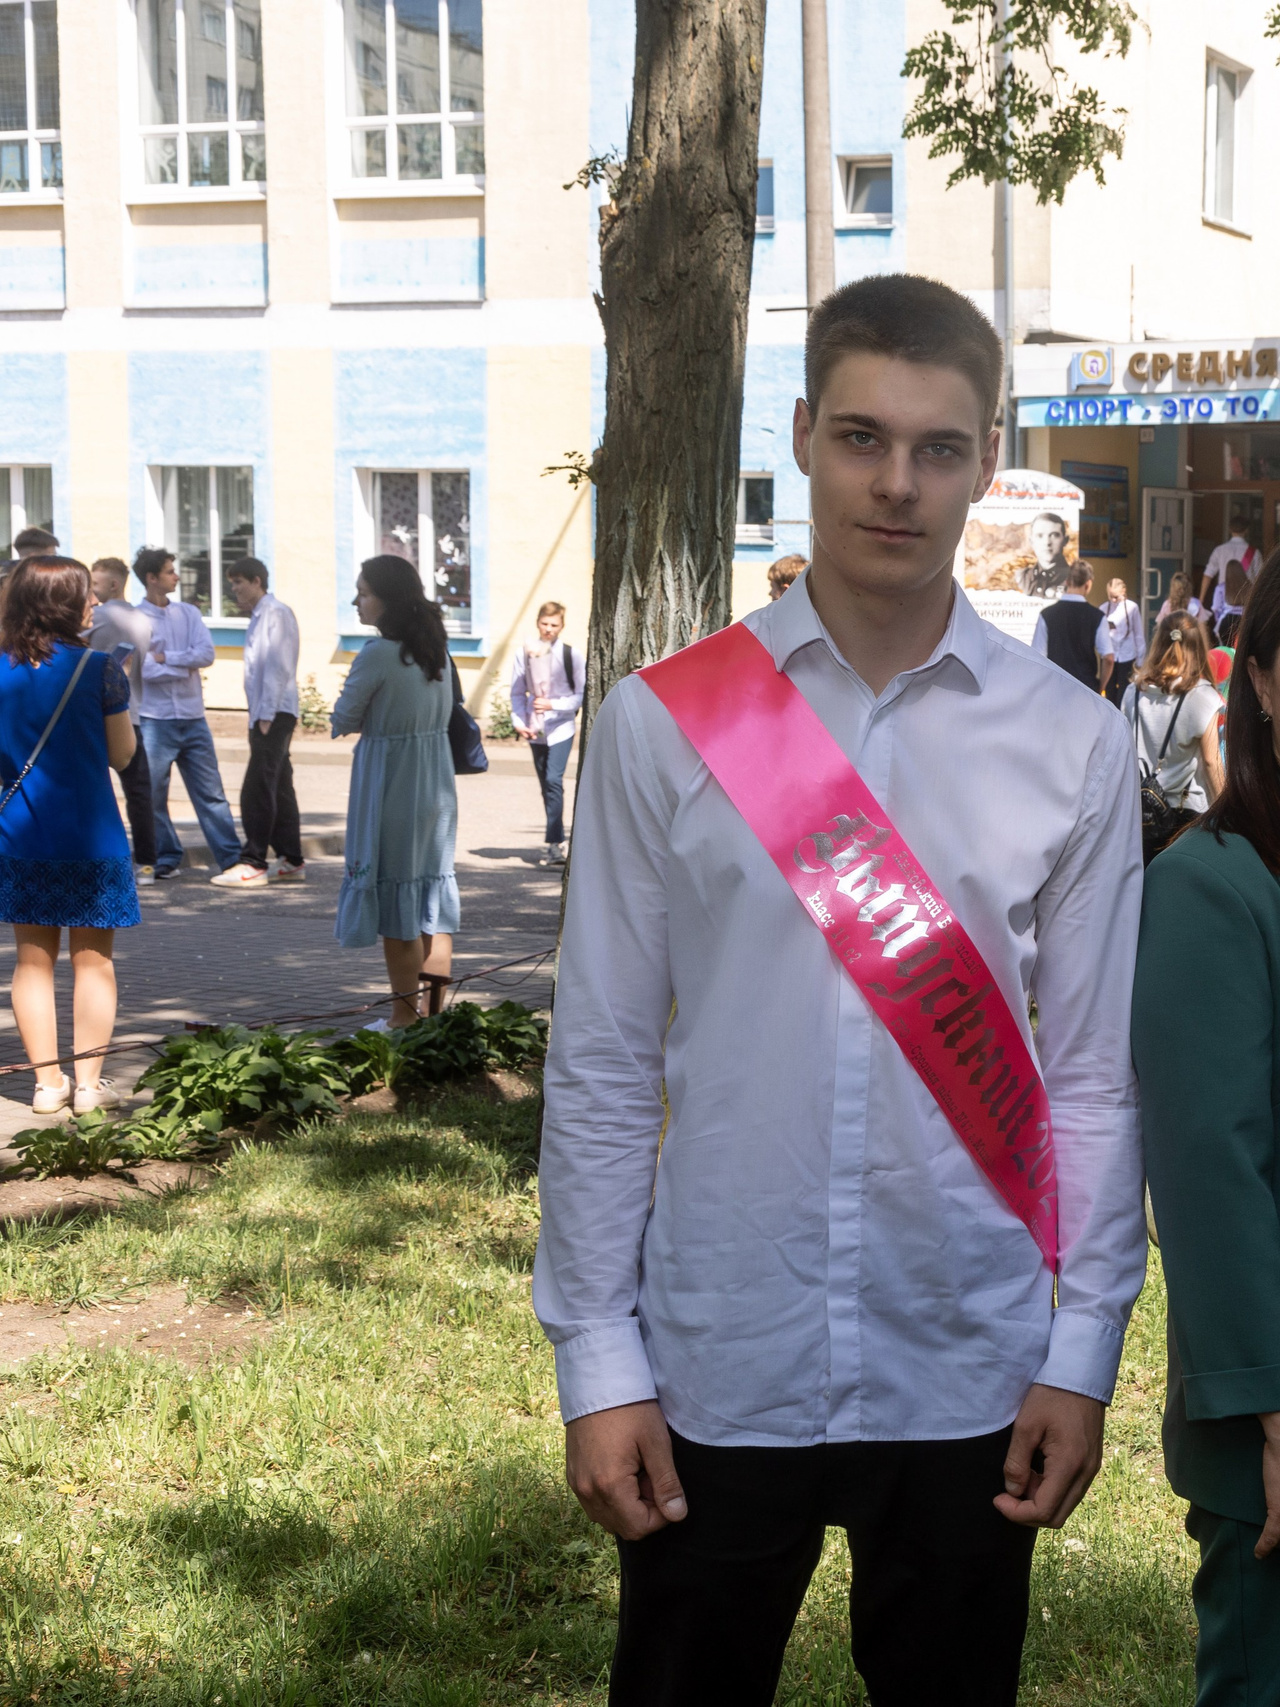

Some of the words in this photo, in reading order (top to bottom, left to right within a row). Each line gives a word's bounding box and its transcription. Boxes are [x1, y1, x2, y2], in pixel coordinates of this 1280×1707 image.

[1048, 398, 1133, 420] СПОРТ
[1163, 397, 1213, 418] ЭТО
[1226, 396, 1268, 418] ТО,
[976, 609, 1024, 618] ИЧУРИН
[806, 890, 836, 928] класс
[793, 808, 1040, 1146] Выпускник
